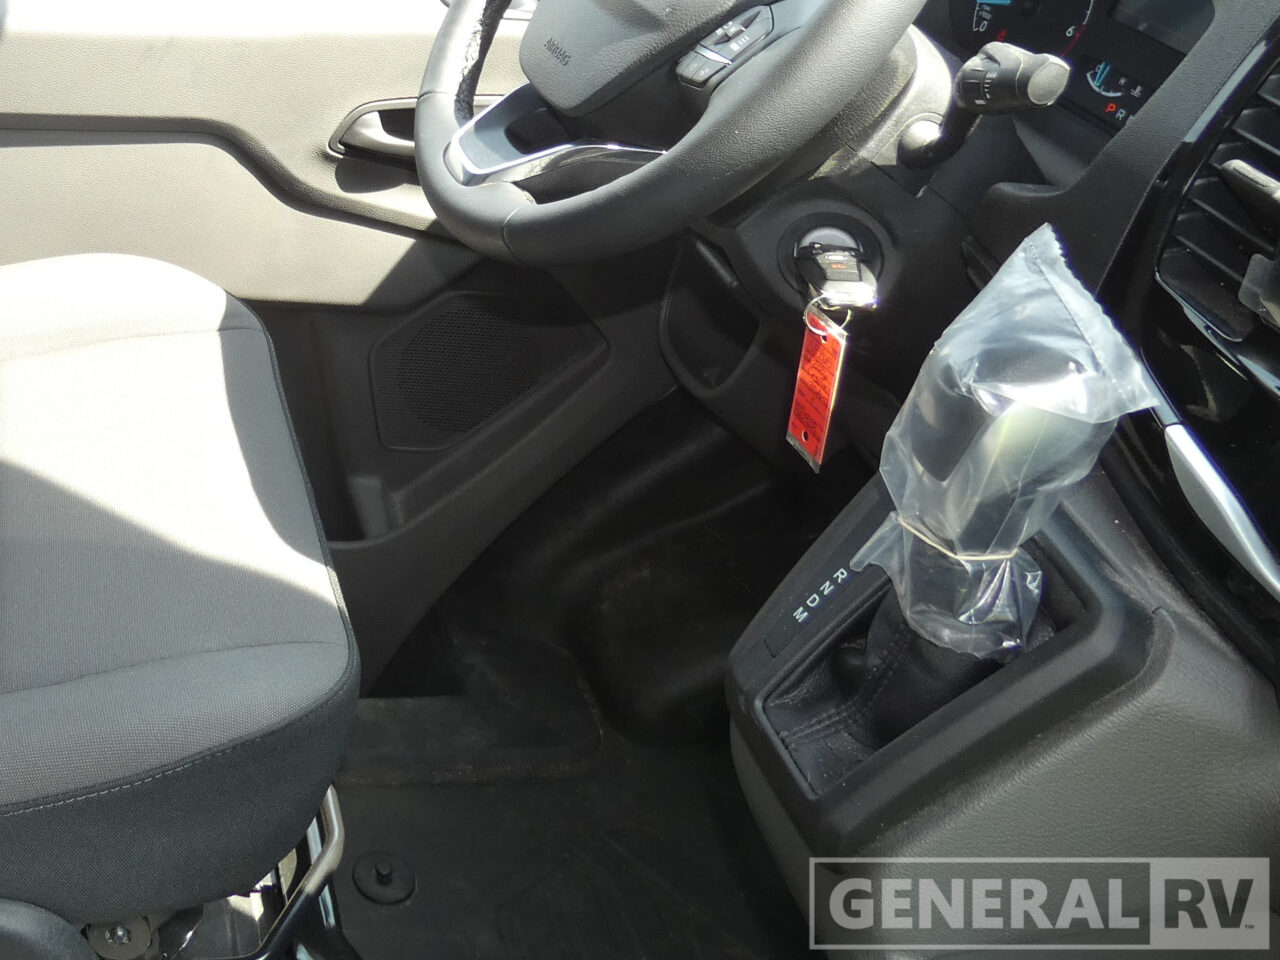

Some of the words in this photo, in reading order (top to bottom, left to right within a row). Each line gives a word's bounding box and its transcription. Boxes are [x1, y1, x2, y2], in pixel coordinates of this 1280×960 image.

[979, 21, 988, 32] 0
[1065, 25, 1075, 37] 6
[1104, 102, 1116, 113] P
[1115, 108, 1126, 121] R
[833, 568, 848, 583] R
[819, 580, 835, 595] N
[806, 593, 820, 607] D
[792, 606, 809, 623] M
